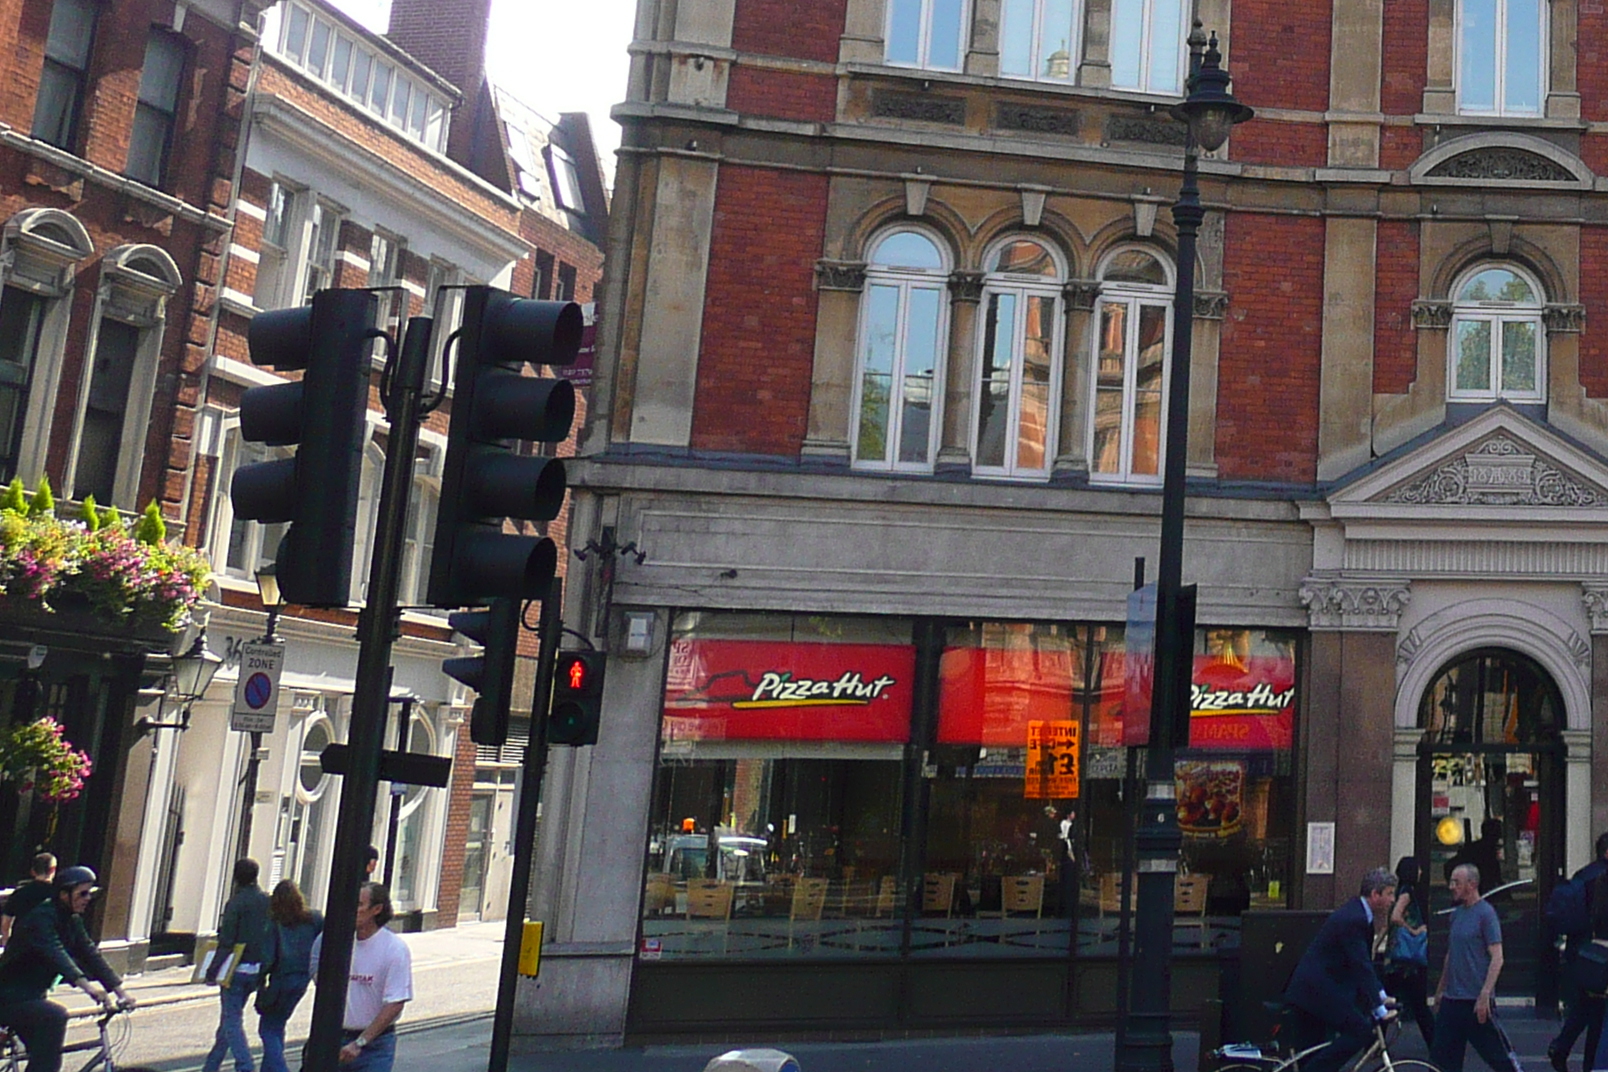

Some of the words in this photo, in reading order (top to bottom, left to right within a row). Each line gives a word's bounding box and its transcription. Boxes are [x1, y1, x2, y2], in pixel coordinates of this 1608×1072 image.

[248, 658, 276, 669] ZONE
[752, 672, 829, 700] Pizza
[832, 671, 896, 698] Hut
[1246, 682, 1295, 709] Hut
